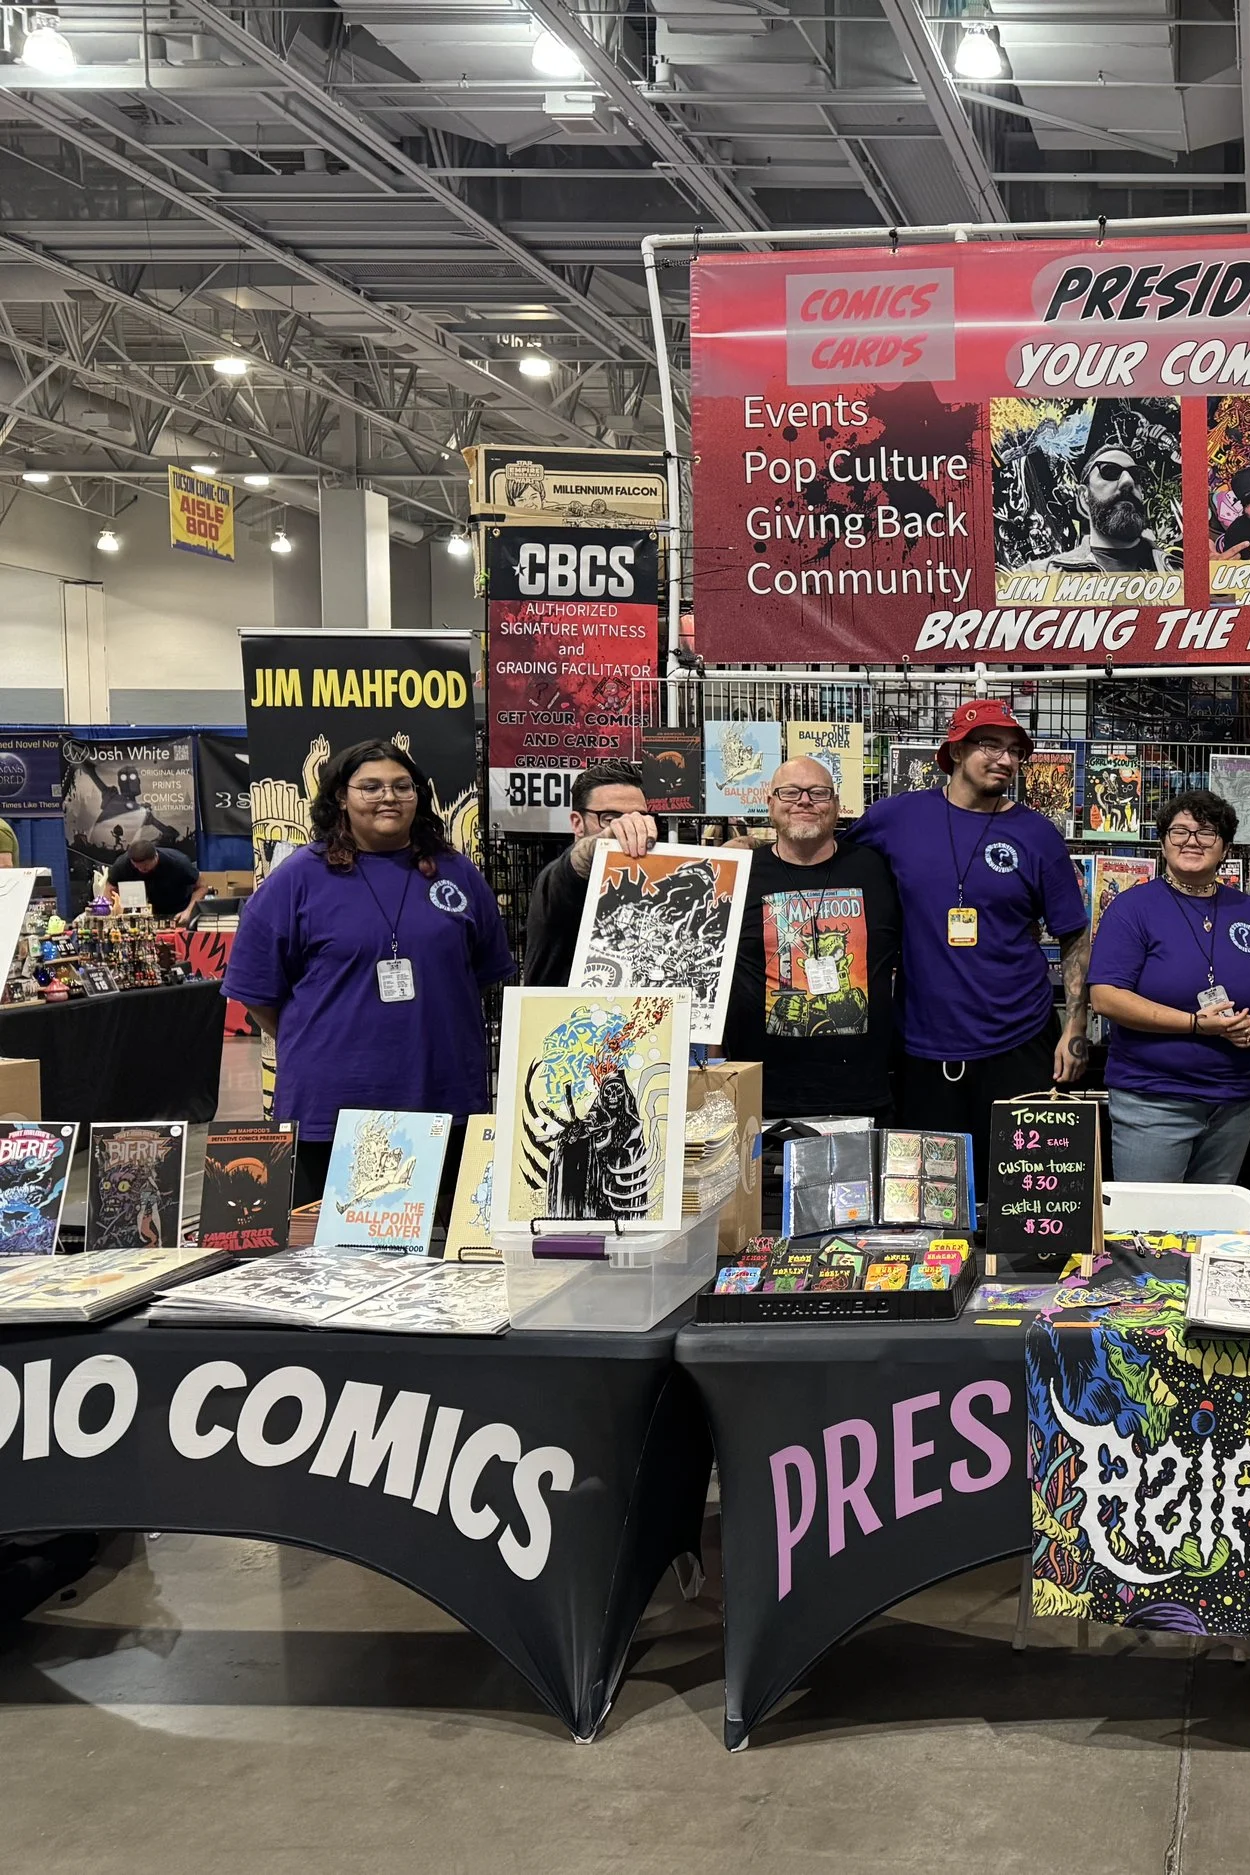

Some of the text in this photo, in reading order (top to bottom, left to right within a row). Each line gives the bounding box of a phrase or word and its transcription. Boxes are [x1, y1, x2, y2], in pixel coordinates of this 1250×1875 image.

[801, 283, 939, 321] COMICS
[811, 334, 928, 370] CARDS
[1014, 340, 1149, 389] YOUR
[744, 394, 868, 429] Events
[744, 446, 968, 493] Pop Culture
[172, 471, 196, 496] TUCSON
[553, 485, 658, 497] MILLENNIUM FALCON
[180, 495, 225, 525] AISLE
[186, 516, 220, 542] 800
[746, 502, 969, 548] Giving Back
[519, 543, 635, 598] CBCS
[746, 561, 972, 602] Community
[996, 573, 1182, 603] JIM MAHFOOD
[526, 602, 618, 618] AUTHORIZED
[500, 622, 646, 639] SIGNATURE WITNESS
[914, 608, 1139, 652] BRINGING
[1155, 608, 1241, 650] THE
[558, 641, 585, 656] and
[496, 660, 651, 678] GRADING FACILITATOR
[251, 668, 468, 709] JIM MAHFOOD
[497, 711, 650, 728] GET YOUR COMICS
[798, 731, 850, 741] BALLPOINT
[831, 724, 850, 733] THE
[15, 741, 41, 749] Novel
[523, 733, 619, 749] AND CARDS
[814, 738, 851, 749] SLAYER
[90, 746, 170, 761] Josh White
[515, 755, 581, 769] GRADED
[152, 780, 182, 789] PRINTS
[724, 787, 771, 797] BALLPOIN
[143, 793, 185, 802] COMICS
[1010, 1107, 1080, 1126] TOKENS:
[1013, 1128, 1070, 1150] $2 EACH
[998, 1160, 1044, 1174] CUSTOM
[1021, 1174, 1058, 1191] $30
[403, 1202, 425, 1213] THE
[1046, 1201, 1082, 1214] CARD:
[345, 1210, 424, 1224] BALLPOINT
[240, 1228, 274, 1239] STREET
[368, 1224, 421, 1238] SLAYER
[1023, 1219, 1064, 1235] $30
[168, 1360, 575, 1581] COMICS
